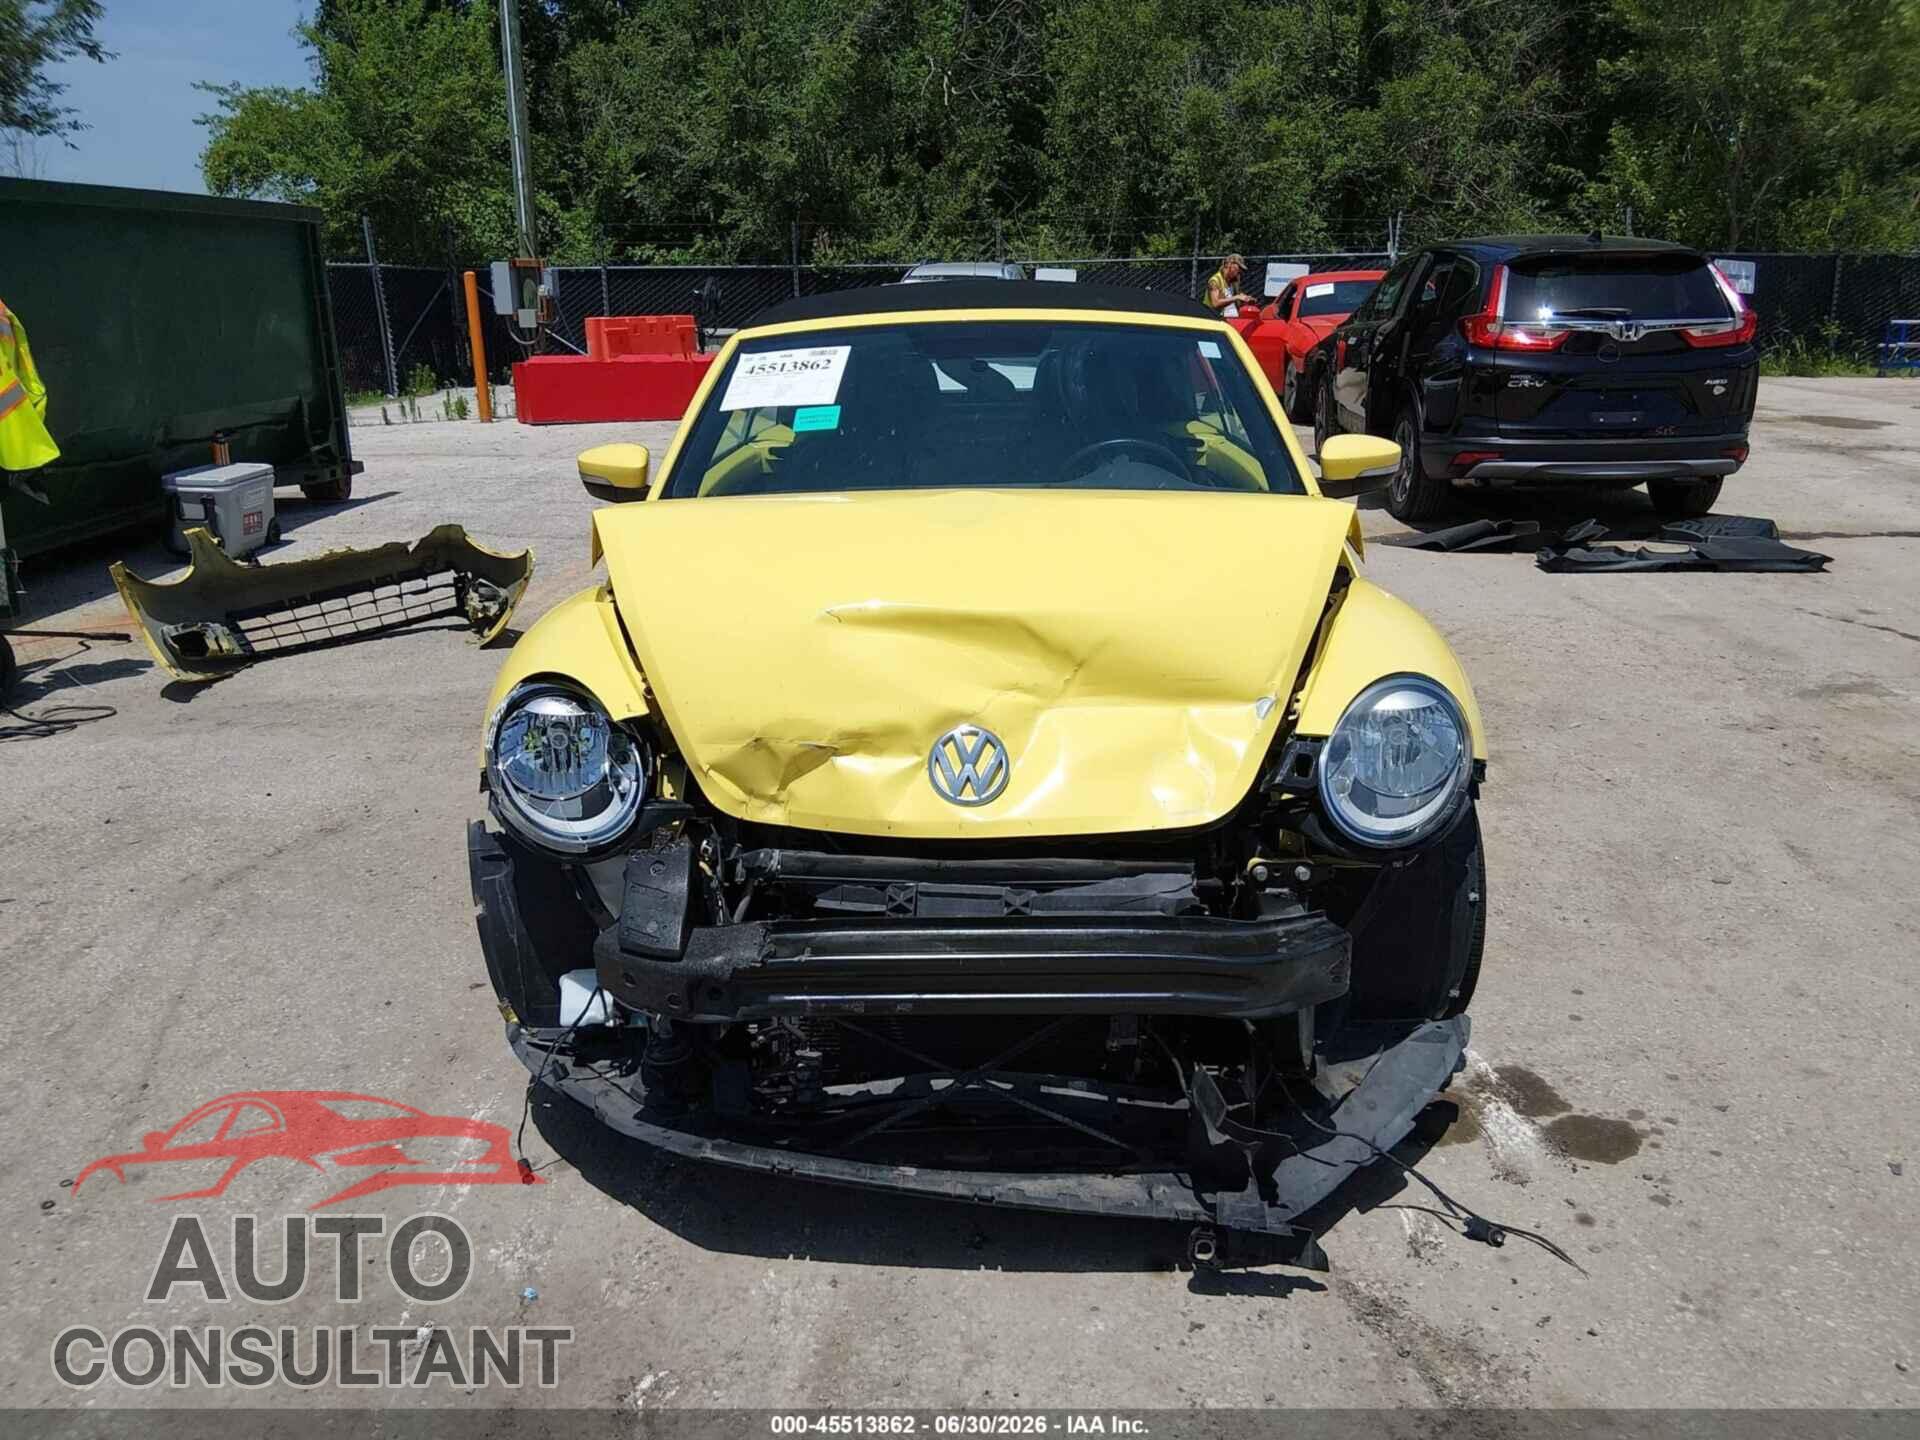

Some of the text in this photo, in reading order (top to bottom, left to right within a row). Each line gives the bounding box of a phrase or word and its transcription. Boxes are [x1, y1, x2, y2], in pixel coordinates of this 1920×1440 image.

[745, 358, 832, 375] 45513862
[1507, 379, 1548, 388] CR-V
[929, 724, 1010, 807] VW
